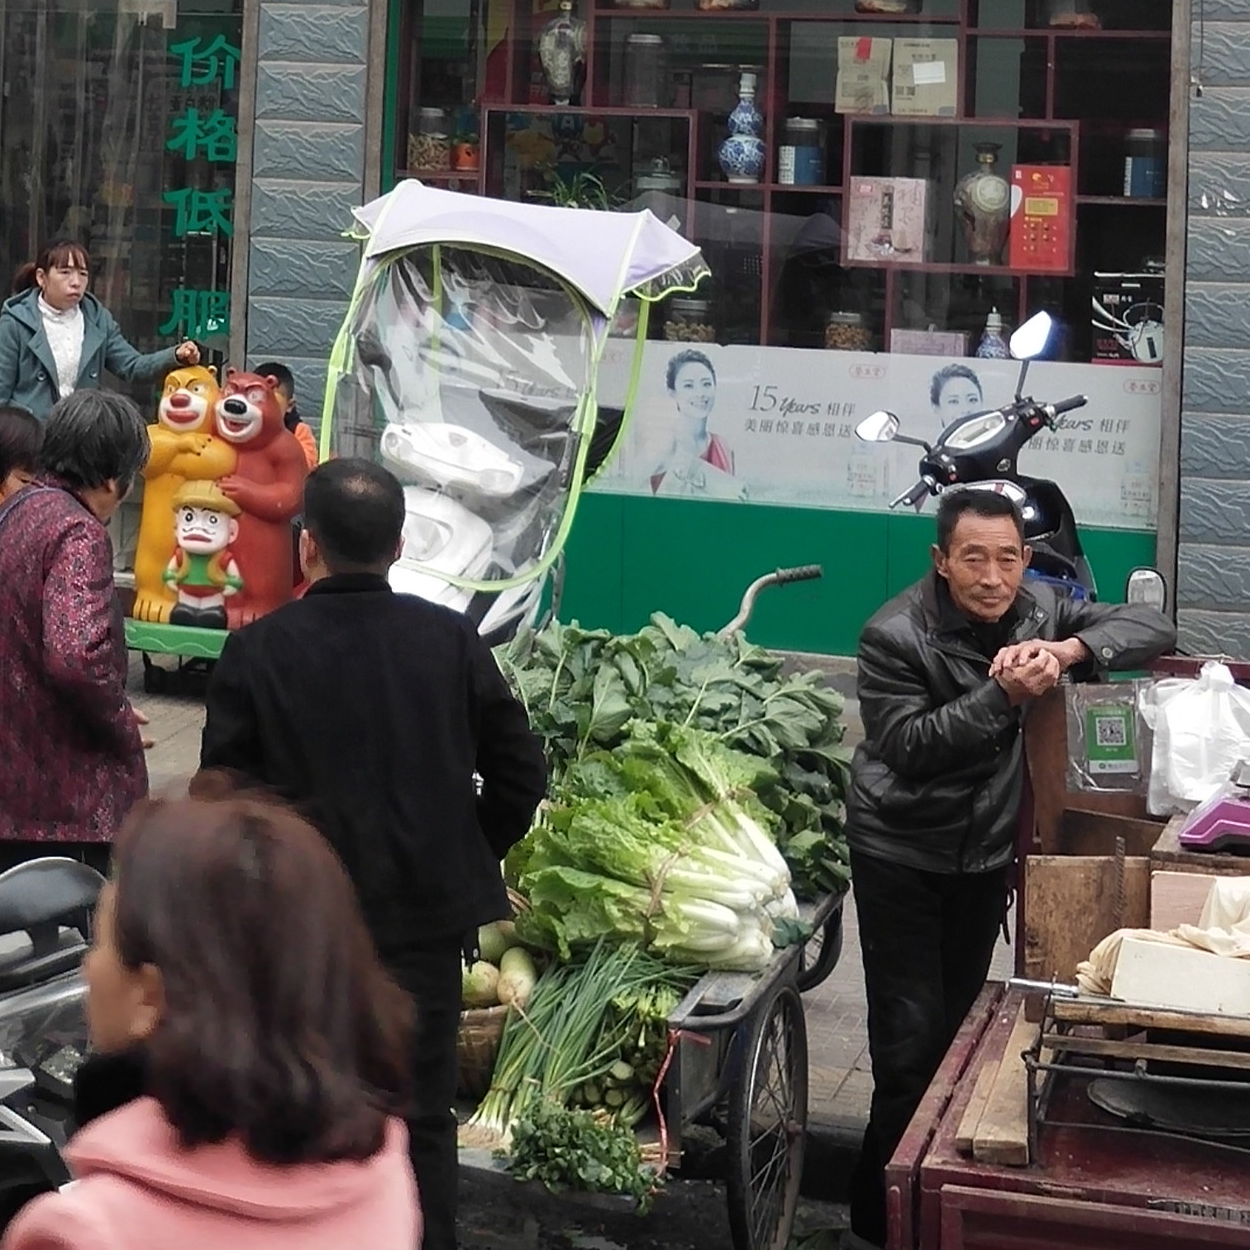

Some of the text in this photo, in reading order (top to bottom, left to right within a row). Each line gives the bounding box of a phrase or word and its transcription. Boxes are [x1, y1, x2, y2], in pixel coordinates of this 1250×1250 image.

[161, 34, 241, 238] 价格低
[749, 384, 856, 418] 15 Years 相伴
[744, 418, 852, 438] 美丽惊喜感恩送
[1100, 418, 1130, 434] 相伴
[1028, 436, 1127, 456] 丽惊喜感恩送
